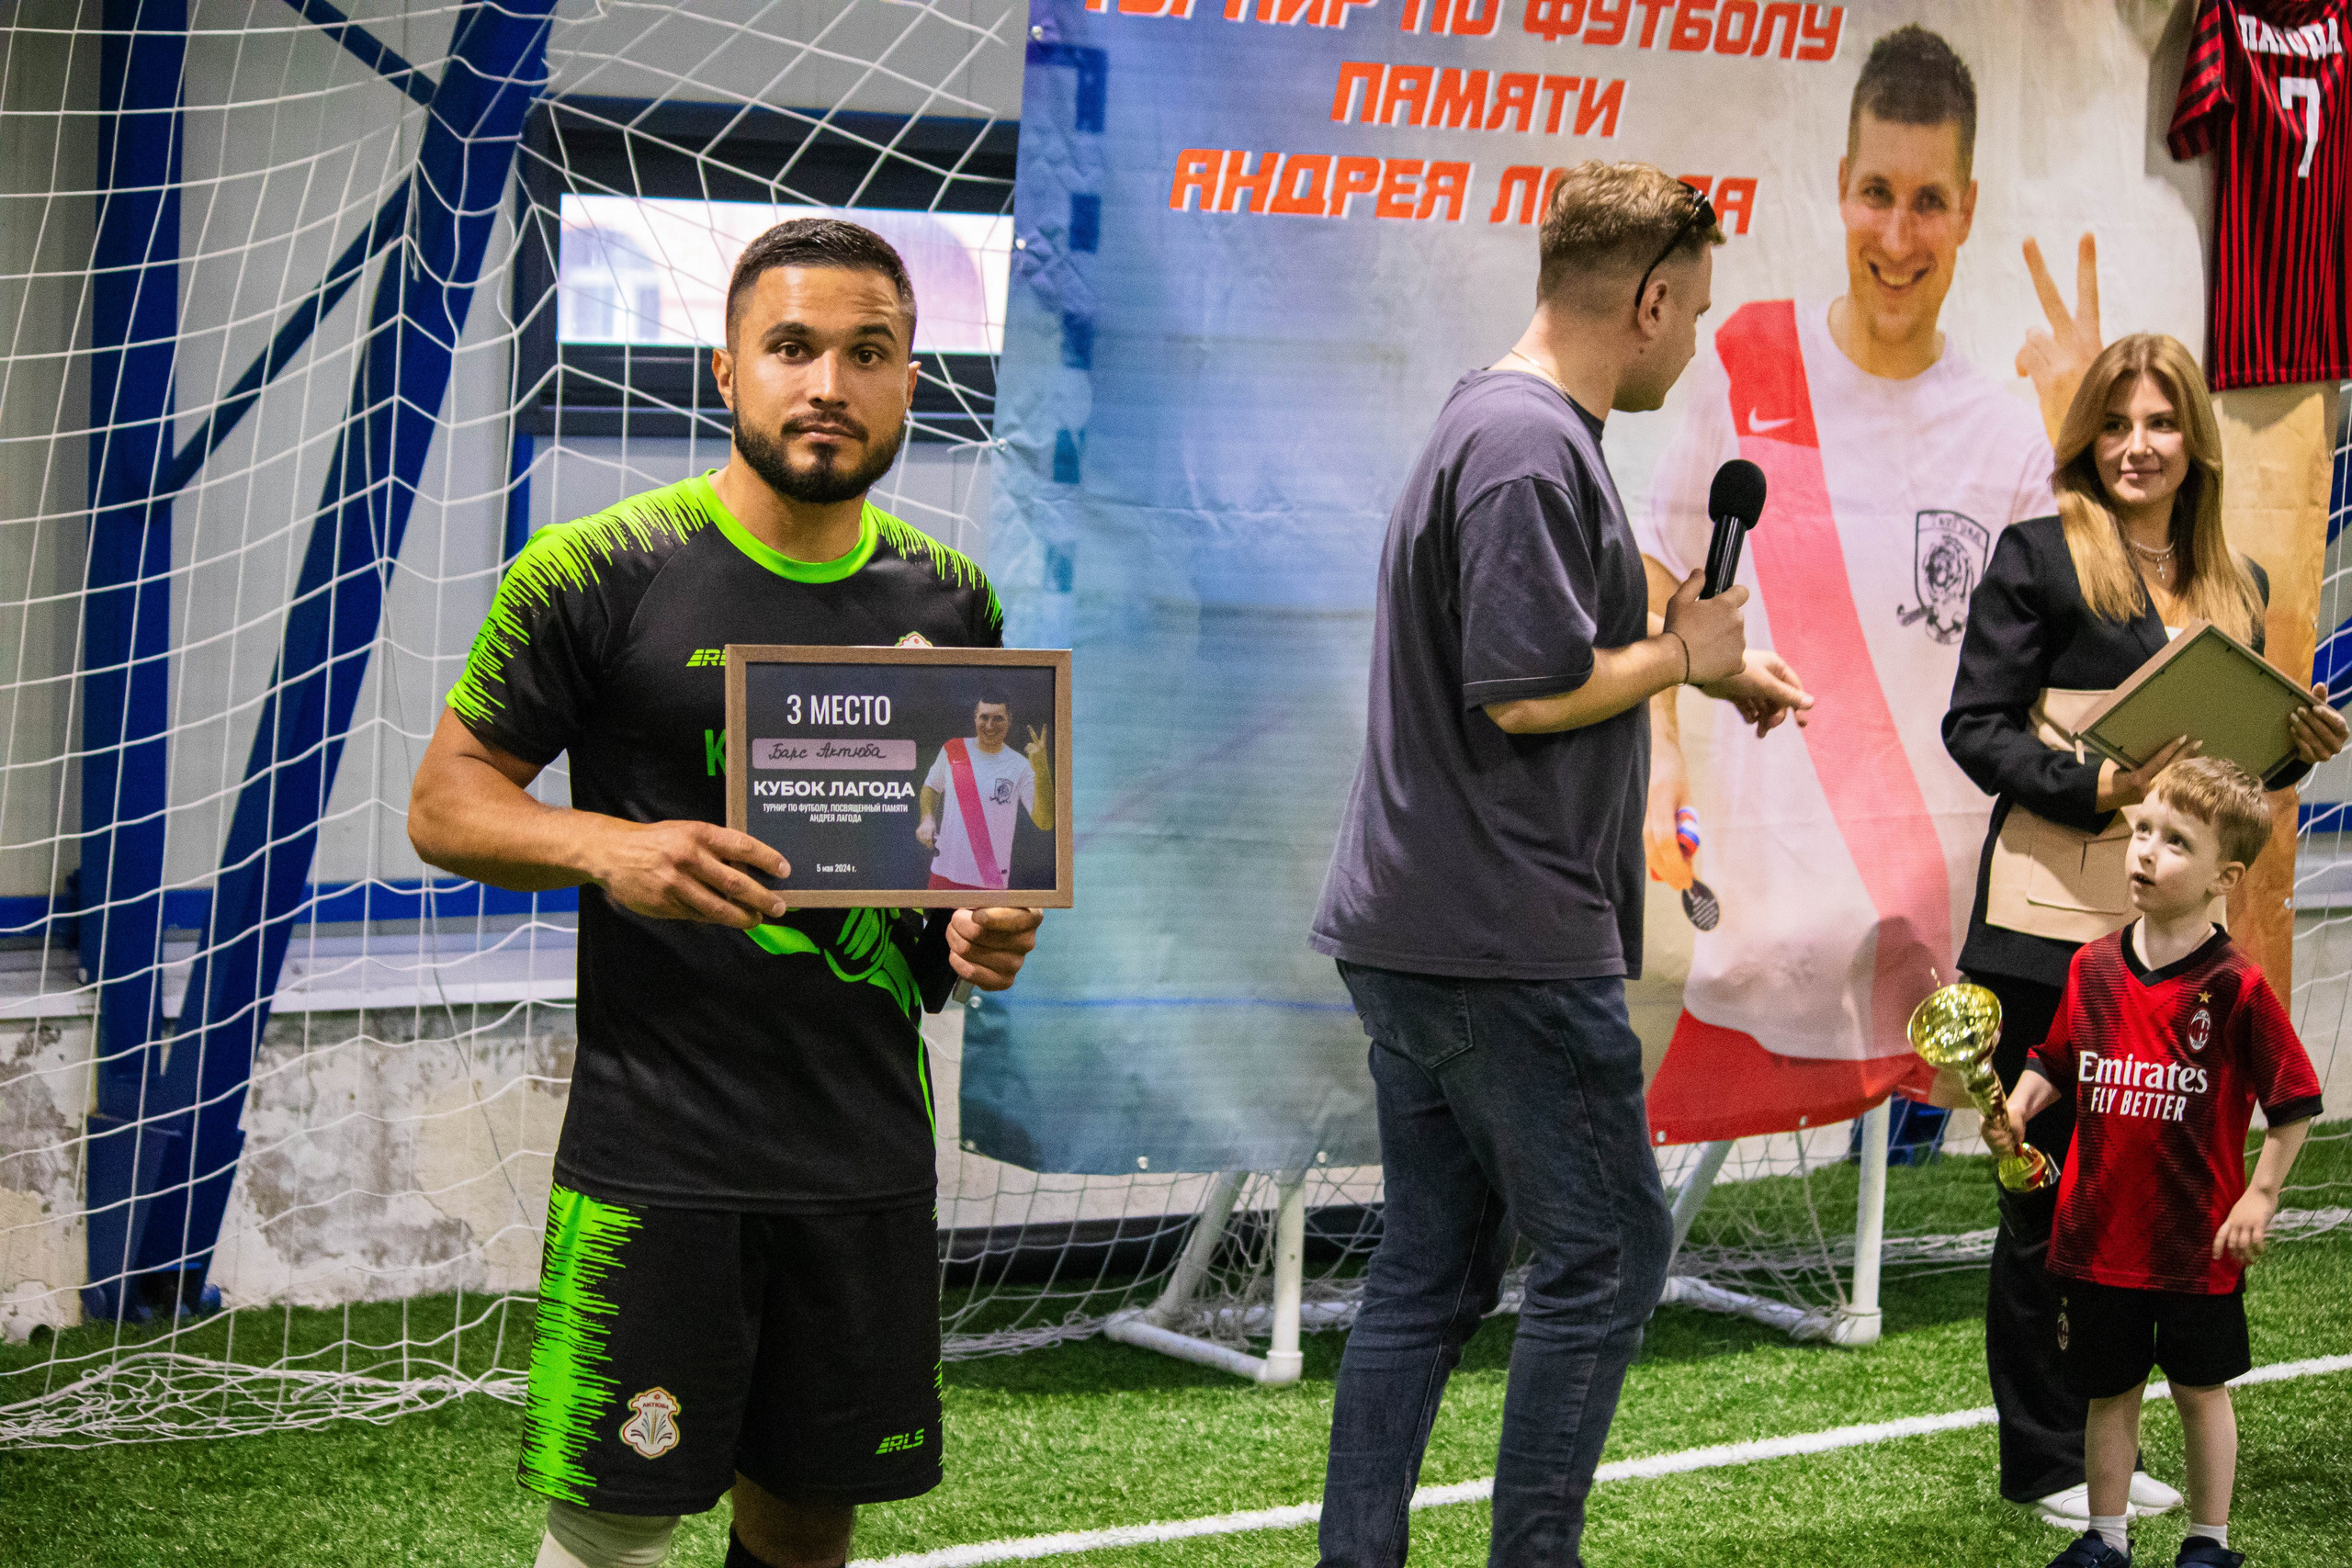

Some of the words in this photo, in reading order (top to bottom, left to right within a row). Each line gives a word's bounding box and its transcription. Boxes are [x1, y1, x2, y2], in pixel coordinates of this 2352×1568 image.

[1522, 0, 1843, 62] ФУТБОЛУ
[1330, 62, 1628, 139] ПАМЯТИ
[2279, 76, 2321, 178] 7
[1169, 148, 1474, 223] АНДРЕЯ
[786, 694, 802, 725] 3
[810, 694, 891, 726] МЕСТО
[768, 742, 808, 761] Барс
[816, 741, 887, 760] Актюба
[753, 781, 826, 796] КУБОК
[829, 781, 915, 799] ЛАГОДА
[763, 803, 787, 813] ТУРНИР
[787, 803, 797, 812] ПО
[830, 802, 880, 813] ПОСВЯЩЕННЫЙ
[882, 804, 908, 813] ПАМЯТИ
[809, 814, 835, 823] АНДРЕЯ
[836, 814, 862, 823] ЛАГОДА
[816, 864, 821, 873] 5
[834, 864, 851, 873] 2024
[2078, 1051, 2208, 1094] Emirates
[2091, 1087, 2118, 1114] FLY
[2120, 1090, 2188, 1122] BETTER
